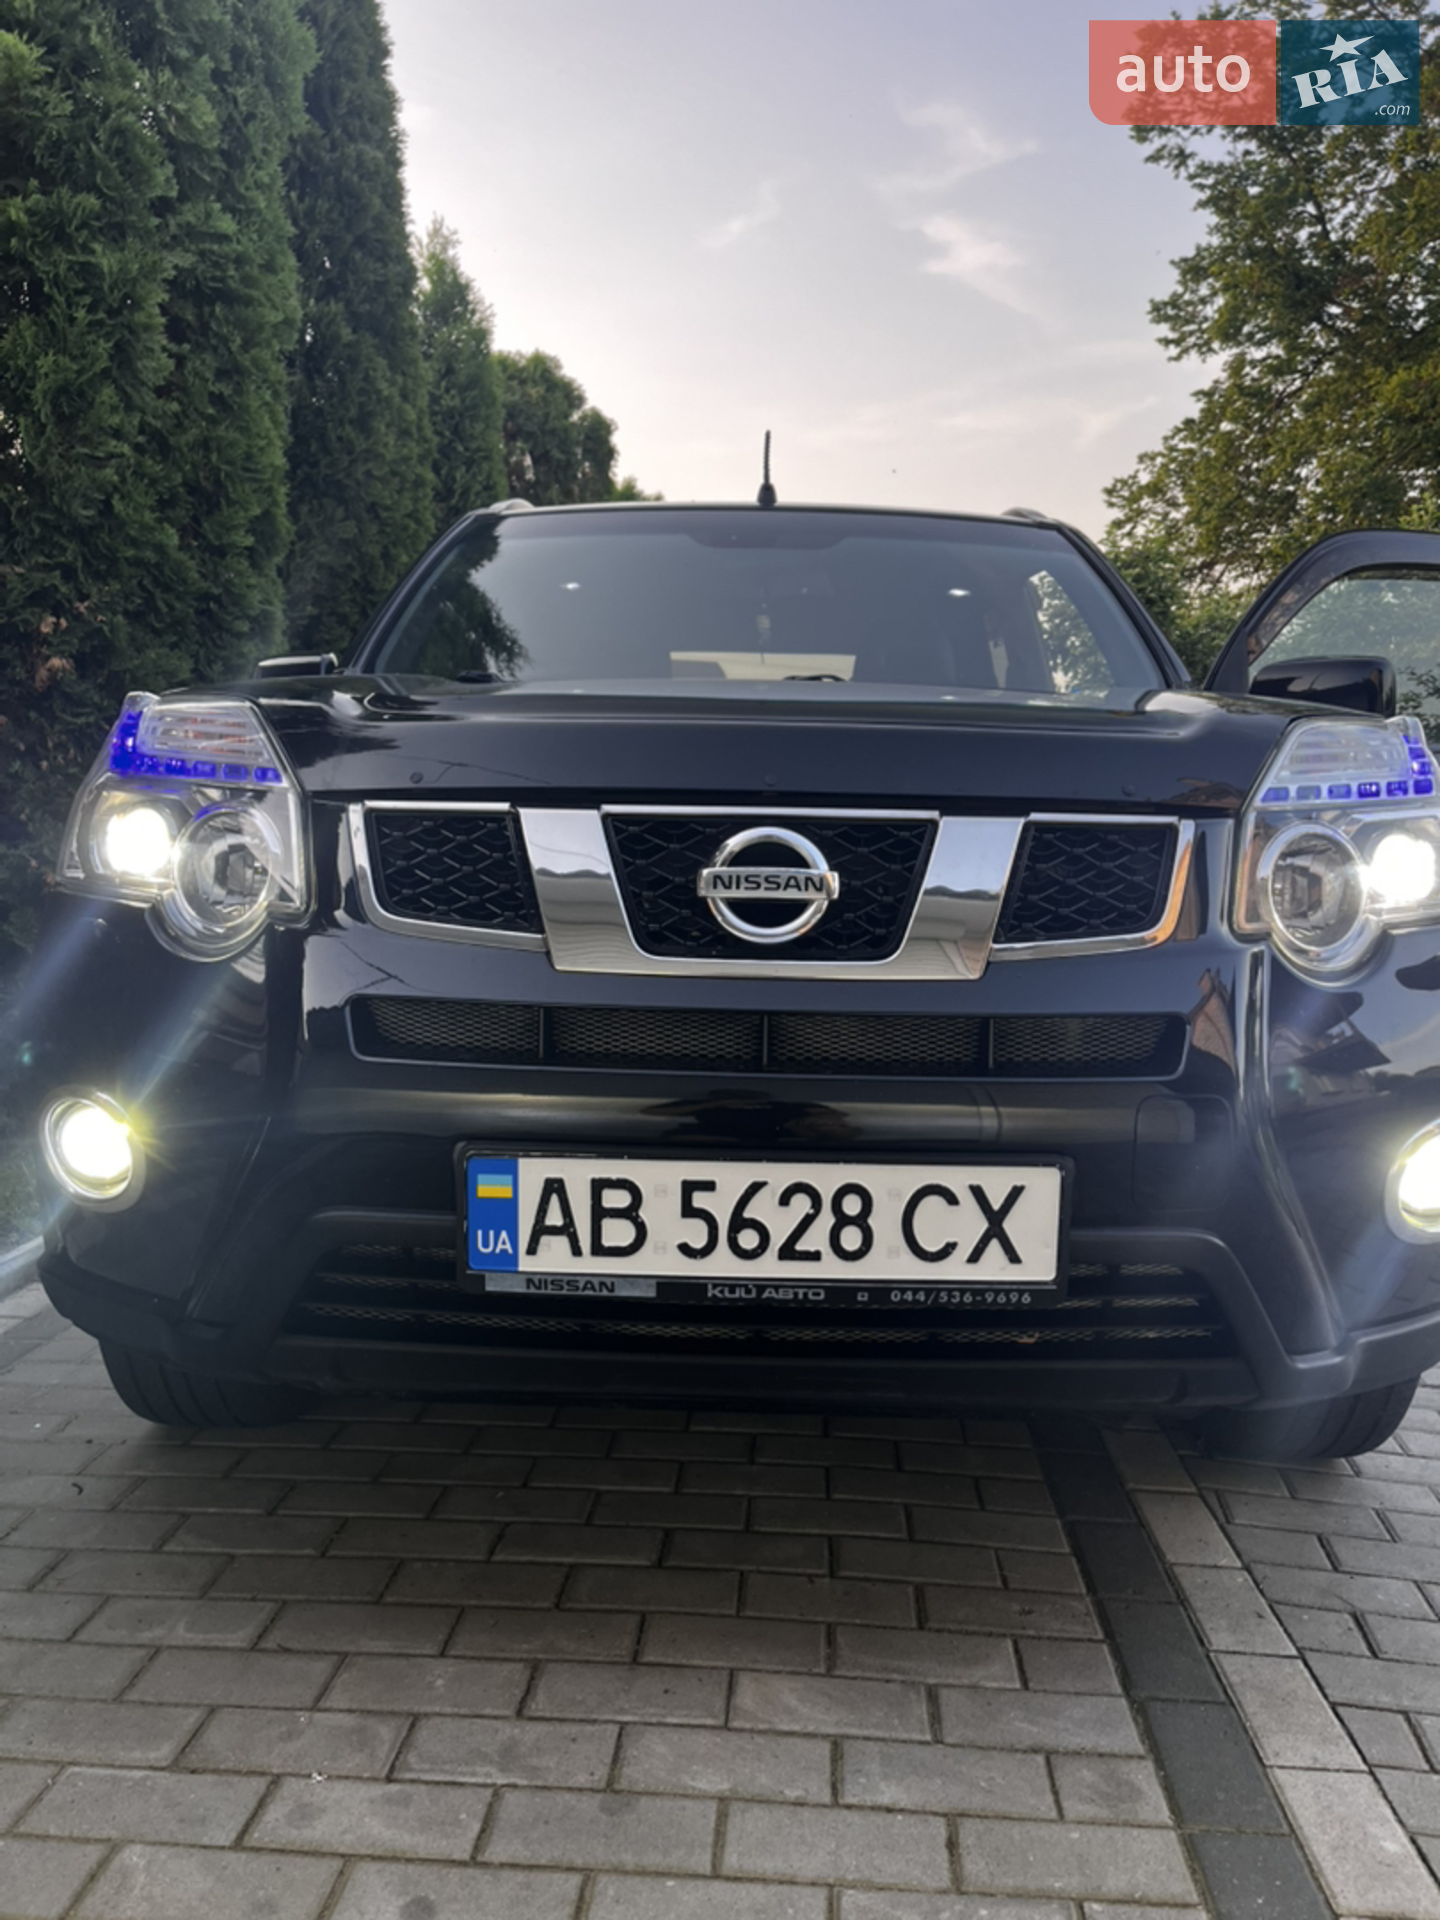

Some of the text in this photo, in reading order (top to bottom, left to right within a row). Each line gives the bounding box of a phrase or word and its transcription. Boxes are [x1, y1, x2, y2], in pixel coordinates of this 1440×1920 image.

[712, 874, 824, 893] NISSAN
[525, 1177, 1026, 1265] AB 5628 CX
[476, 1229, 513, 1255] UA
[525, 1277, 616, 1294] NISSAN
[890, 1290, 1032, 1305] 044/536-9696
